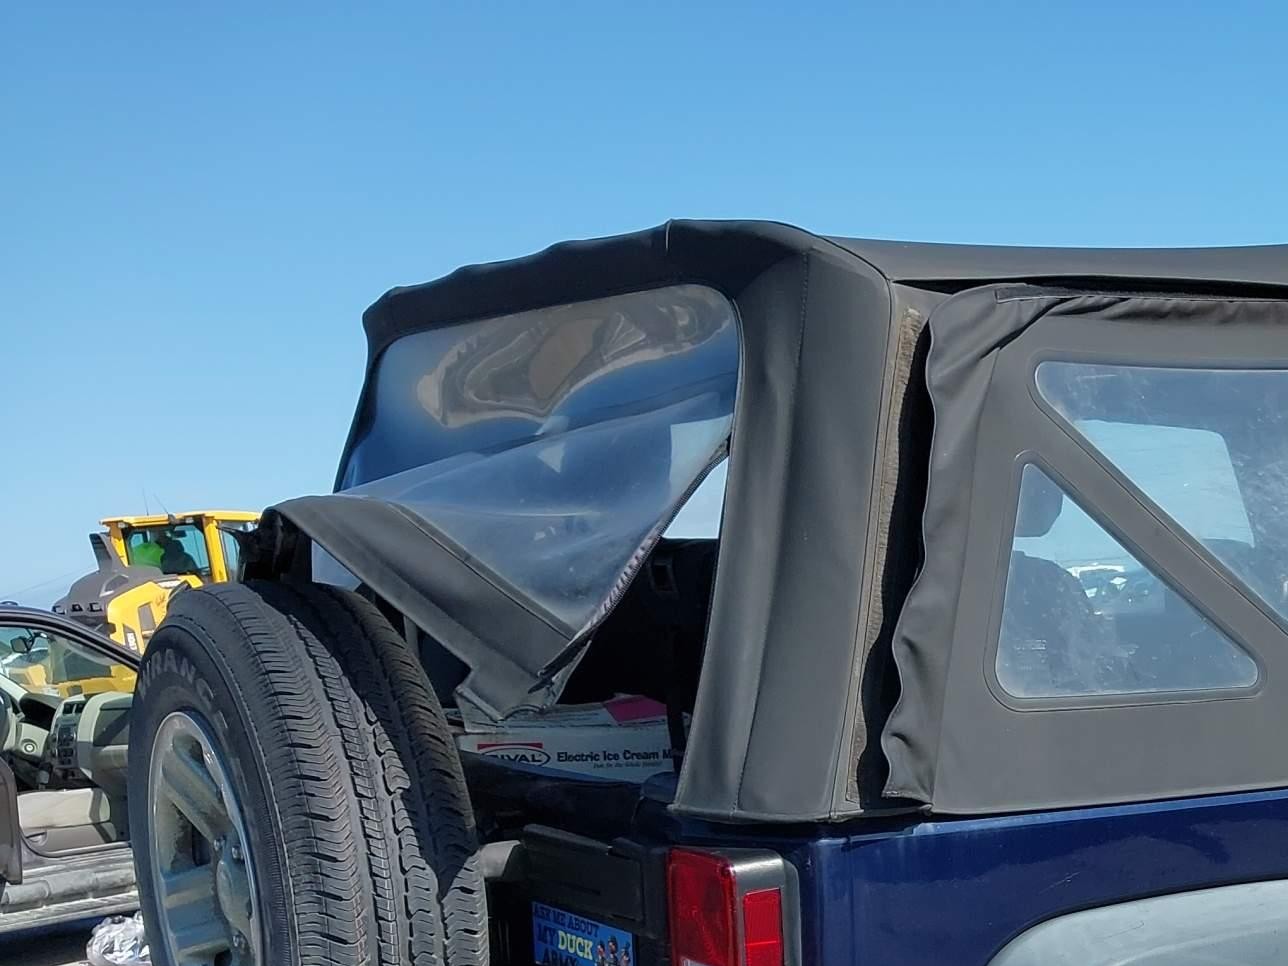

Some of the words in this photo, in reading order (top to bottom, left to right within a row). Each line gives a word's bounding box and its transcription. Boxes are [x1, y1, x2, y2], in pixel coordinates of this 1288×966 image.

[557, 751, 600, 762] Electric
[603, 750, 619, 761] Ice
[623, 750, 659, 761] Cream
[558, 930, 593, 960] DUCK
